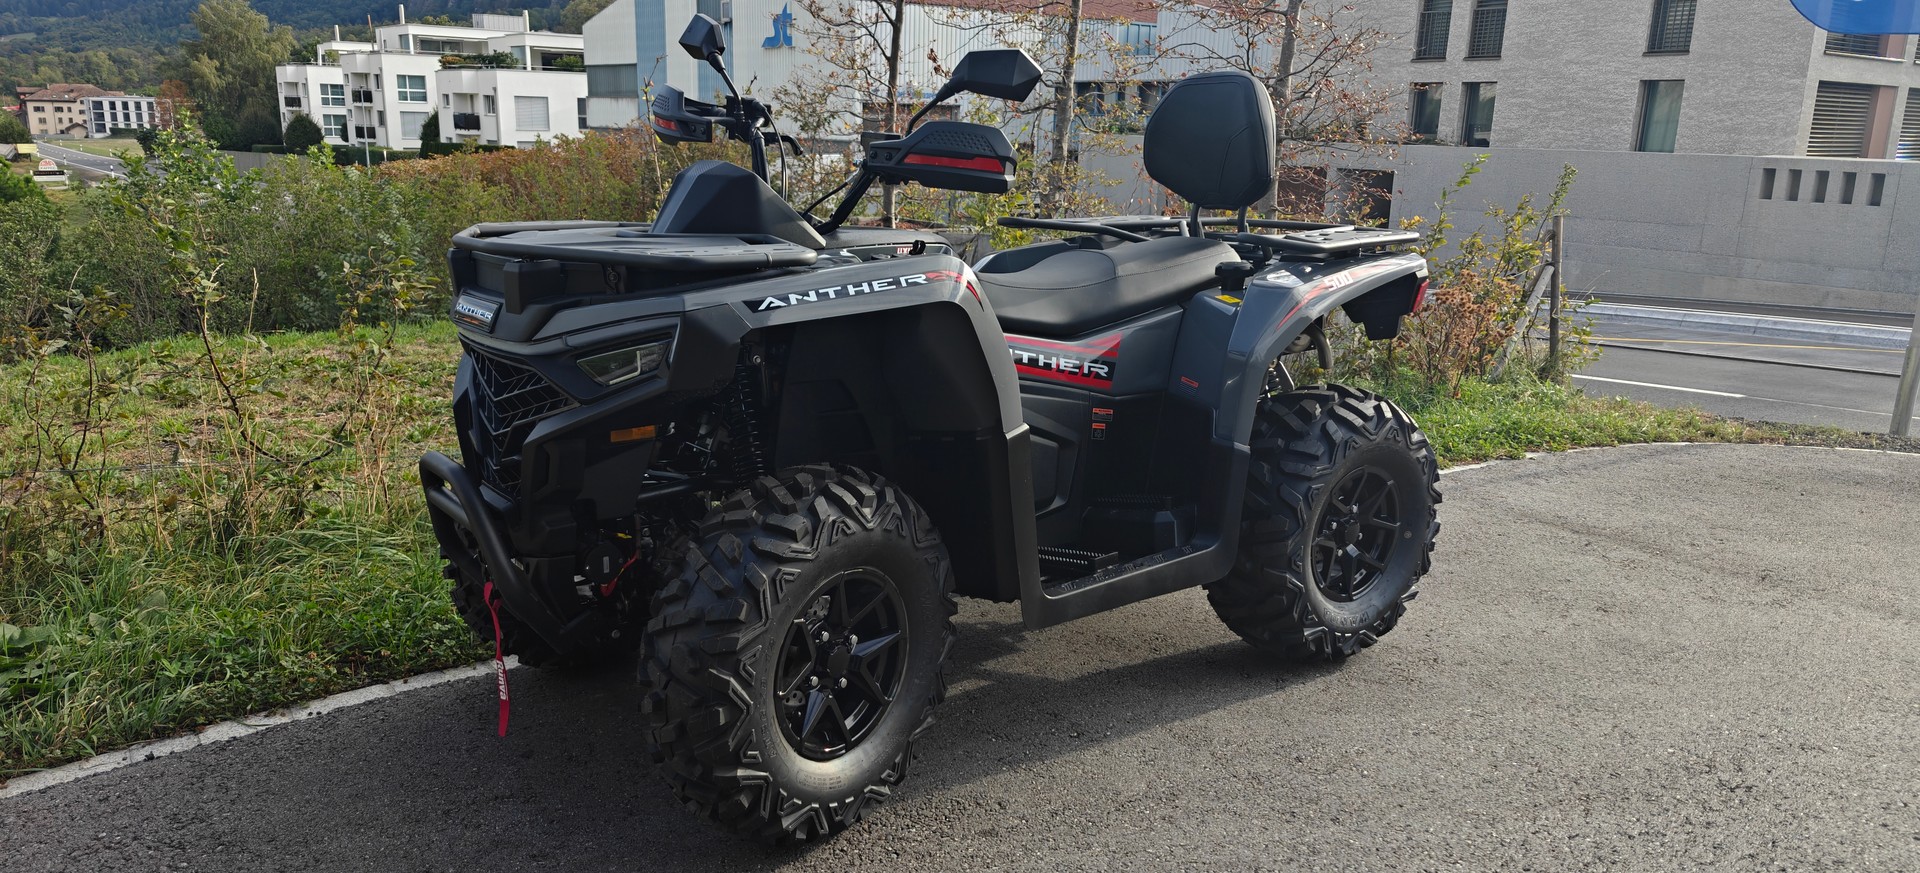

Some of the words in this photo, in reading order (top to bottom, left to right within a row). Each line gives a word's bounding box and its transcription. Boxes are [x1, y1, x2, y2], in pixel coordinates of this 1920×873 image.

[757, 273, 929, 311] ANTHER
[1324, 271, 1354, 292] 500
[496, 660, 507, 700] Runva
